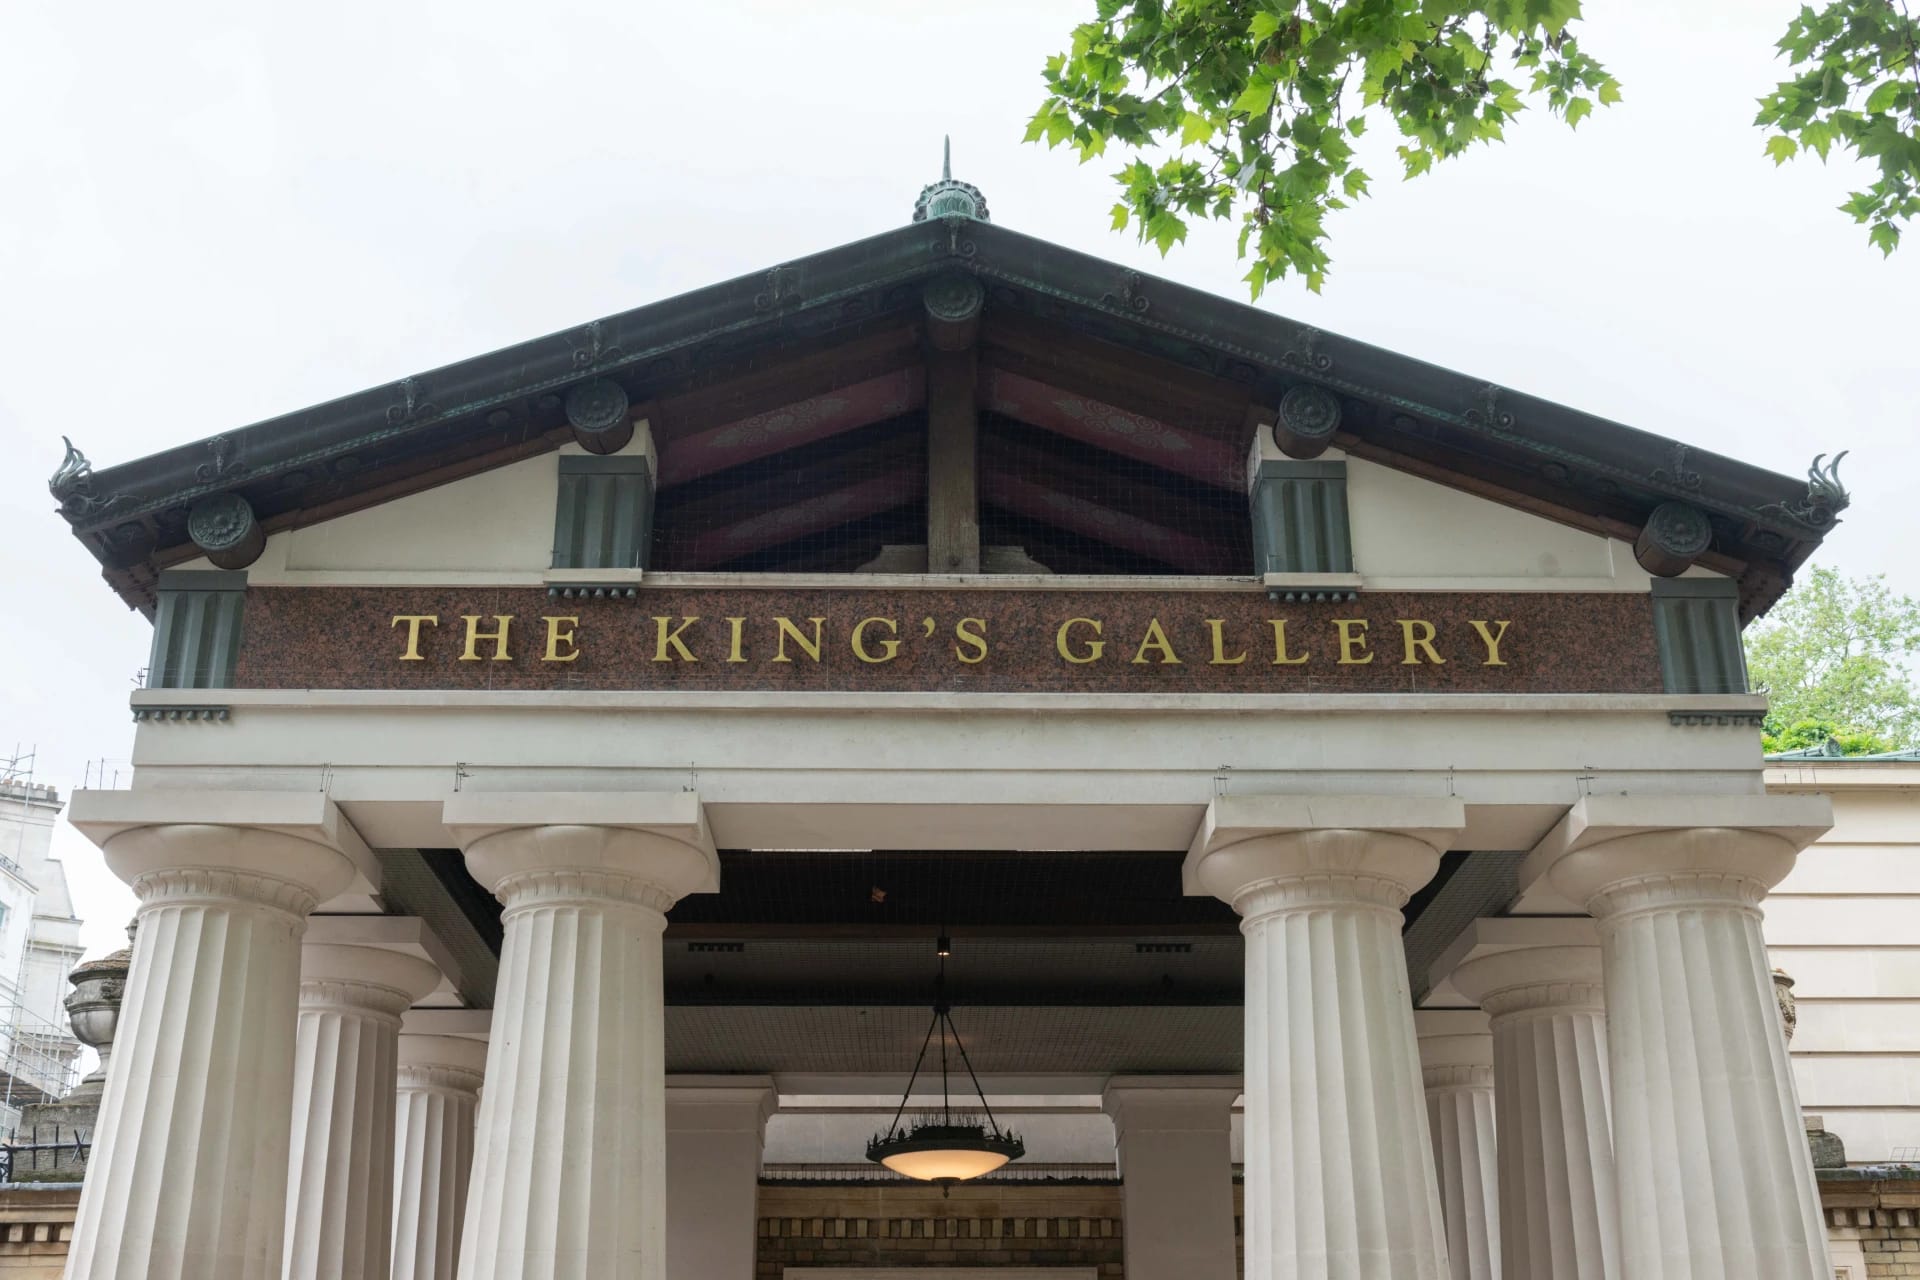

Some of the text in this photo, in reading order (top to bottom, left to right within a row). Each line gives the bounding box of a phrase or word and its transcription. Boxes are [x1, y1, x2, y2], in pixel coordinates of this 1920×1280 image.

[391, 614, 1512, 666] THE KING'S GALLERY
